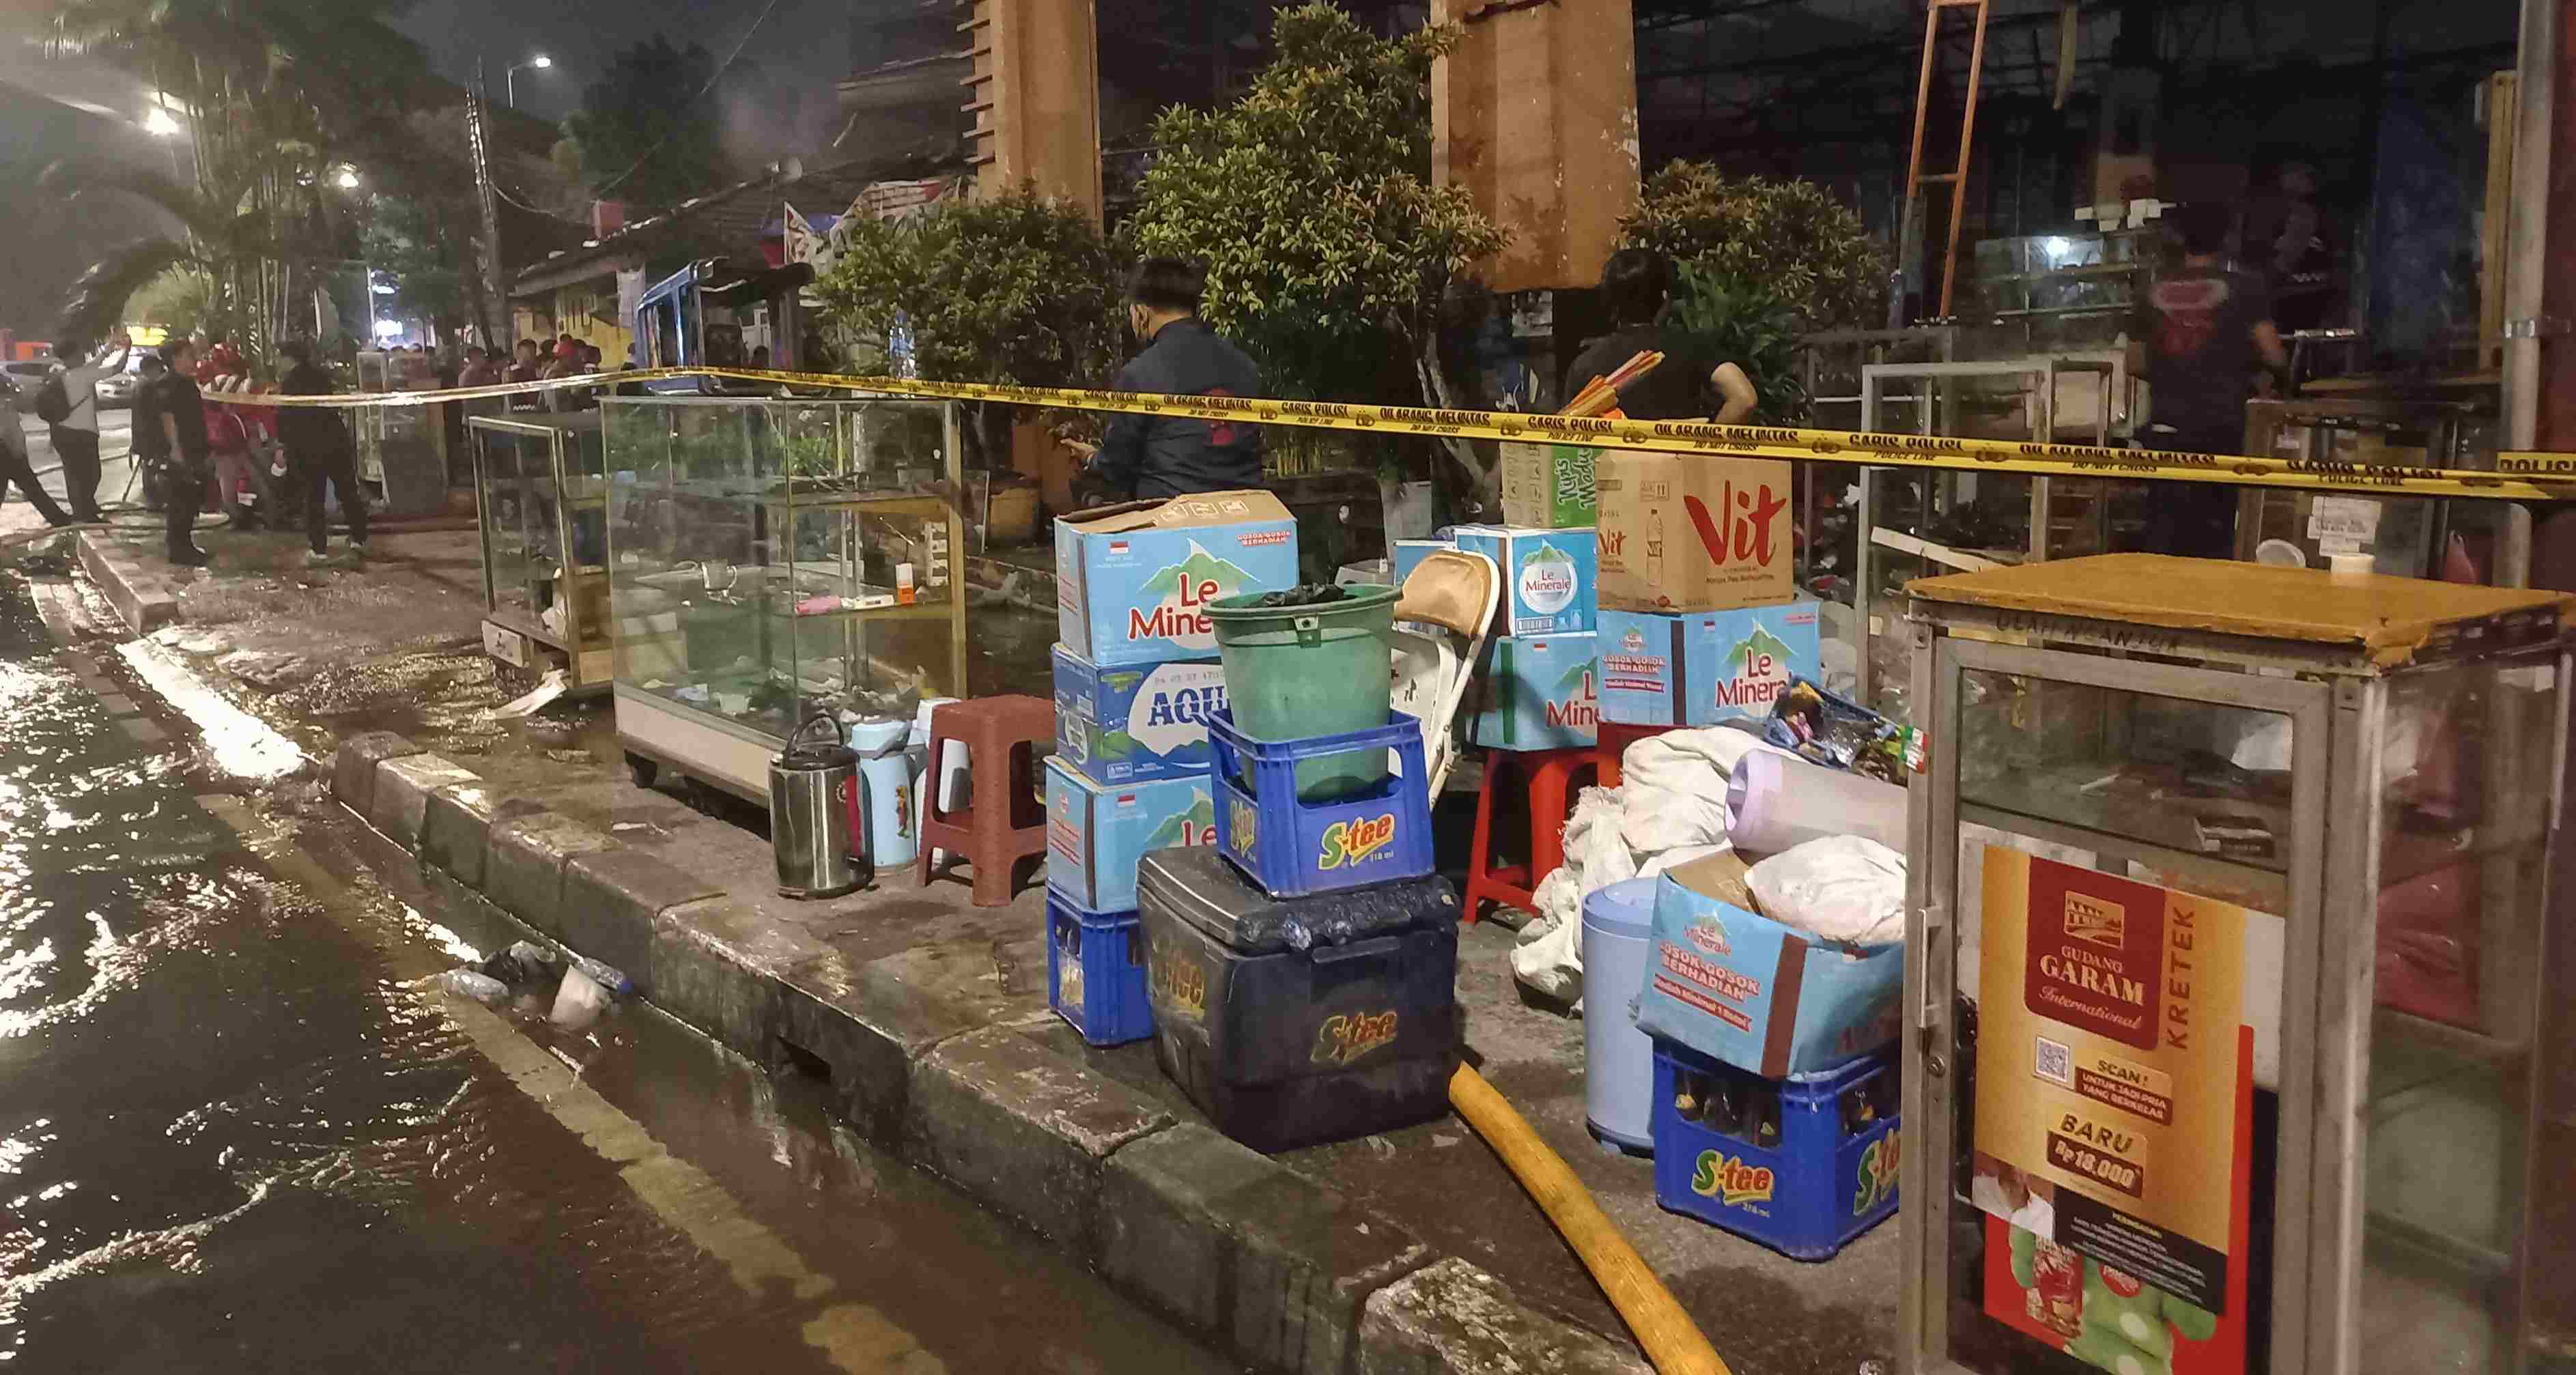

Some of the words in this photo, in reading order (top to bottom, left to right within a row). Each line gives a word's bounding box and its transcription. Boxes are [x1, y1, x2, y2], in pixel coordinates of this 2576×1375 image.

[1163, 394, 1206, 409] DILARANG
[1207, 397, 1253, 412] MELINTAS
[1282, 401, 1312, 416] GARIS
[1314, 403, 1350, 419] POLISI
[1380, 407, 1432, 424] DILARANG
[1434, 410, 1490, 427] MELINTAS
[1528, 416, 1565, 431] GARIS
[1570, 419, 1613, 434] POLISI
[1654, 423, 1723, 440] DILARANG
[1726, 427, 1798, 443] MELINTAS
[1683, 479, 1787, 567] Vit
[1599, 529, 1626, 556] Vit
[1526, 579, 1571, 591] Minerale
[1542, 569, 1554, 580] Le
[1180, 573, 1219, 608] Le
[1747, 649, 1771, 678] Le
[1584, 672, 1597, 700] L
[1318, 813, 1395, 870] S-tee
[2061, 945, 2124, 974] GUDANG
[2040, 954, 2145, 1006] GARAM
[2167, 907, 2196, 1049] KRETEK
[2039, 986, 2142, 1030] International
[2060, 1114, 2134, 1153] BARU
[1692, 1150, 1773, 1199] S-tee
